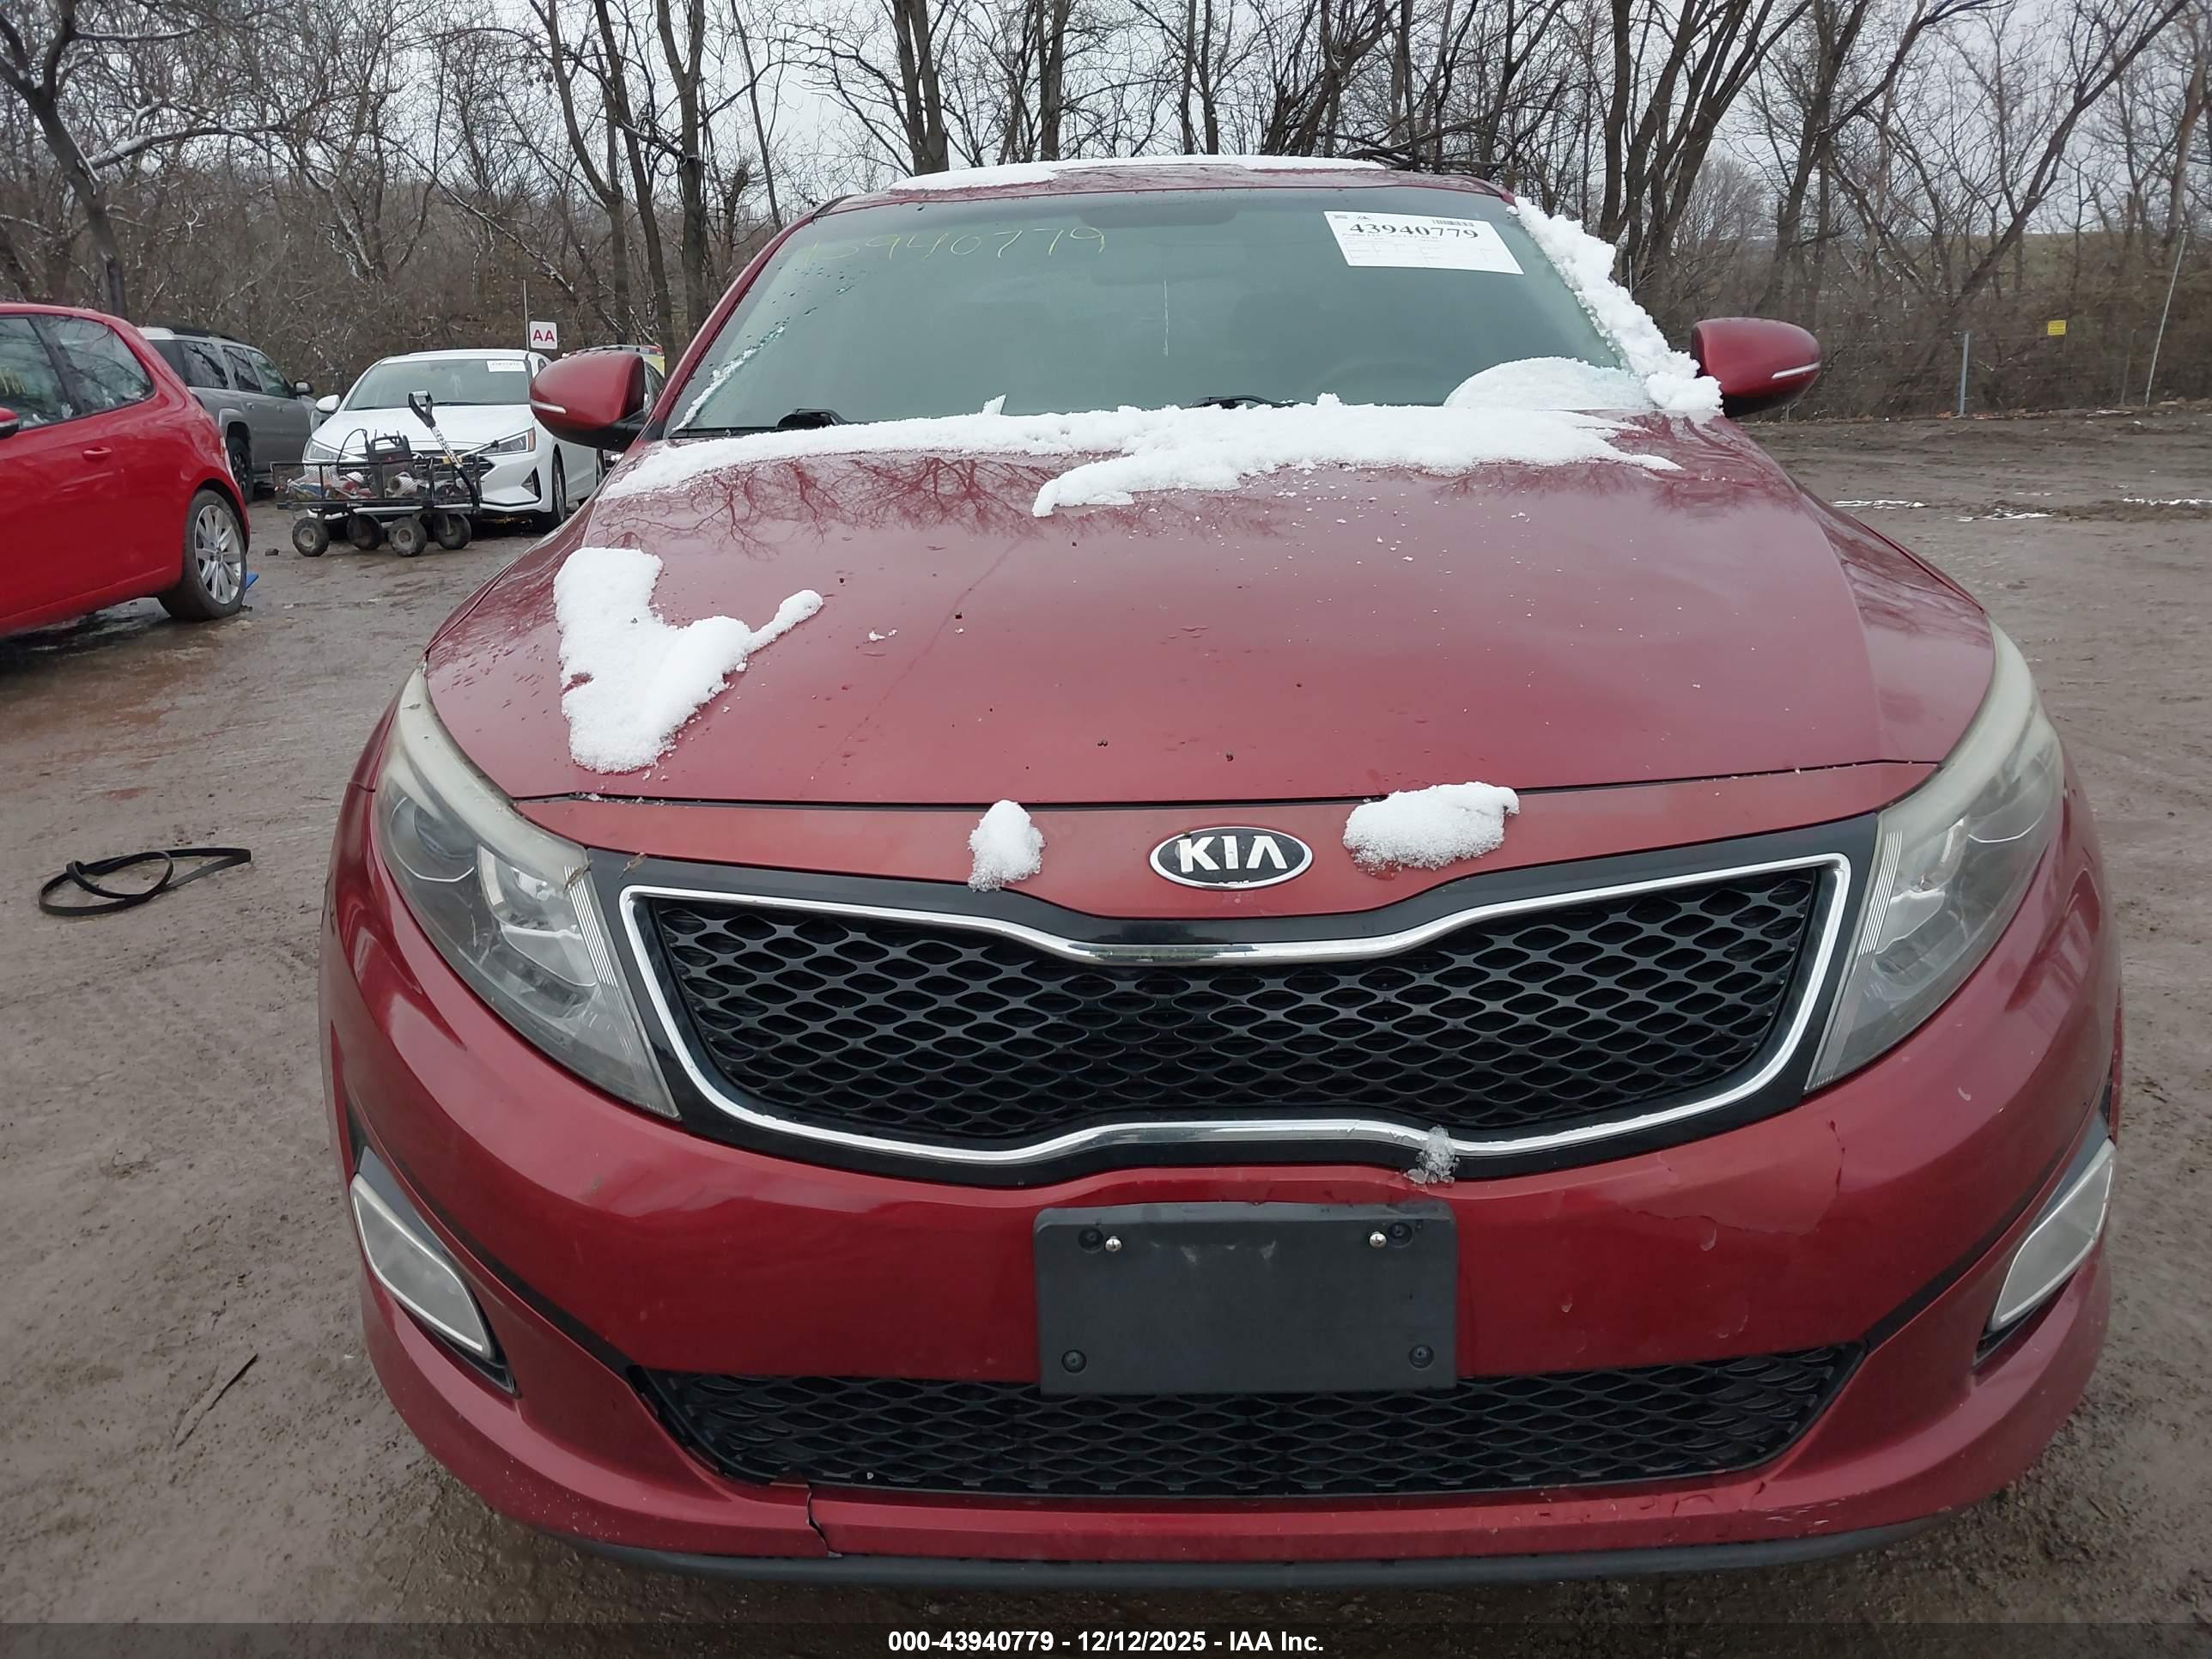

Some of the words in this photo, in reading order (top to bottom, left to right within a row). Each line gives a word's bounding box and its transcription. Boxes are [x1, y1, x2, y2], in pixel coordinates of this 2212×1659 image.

[1349, 223, 1479, 239] 43940779
[532, 329, 556, 342] AA
[1176, 835, 1288, 873] KIA
